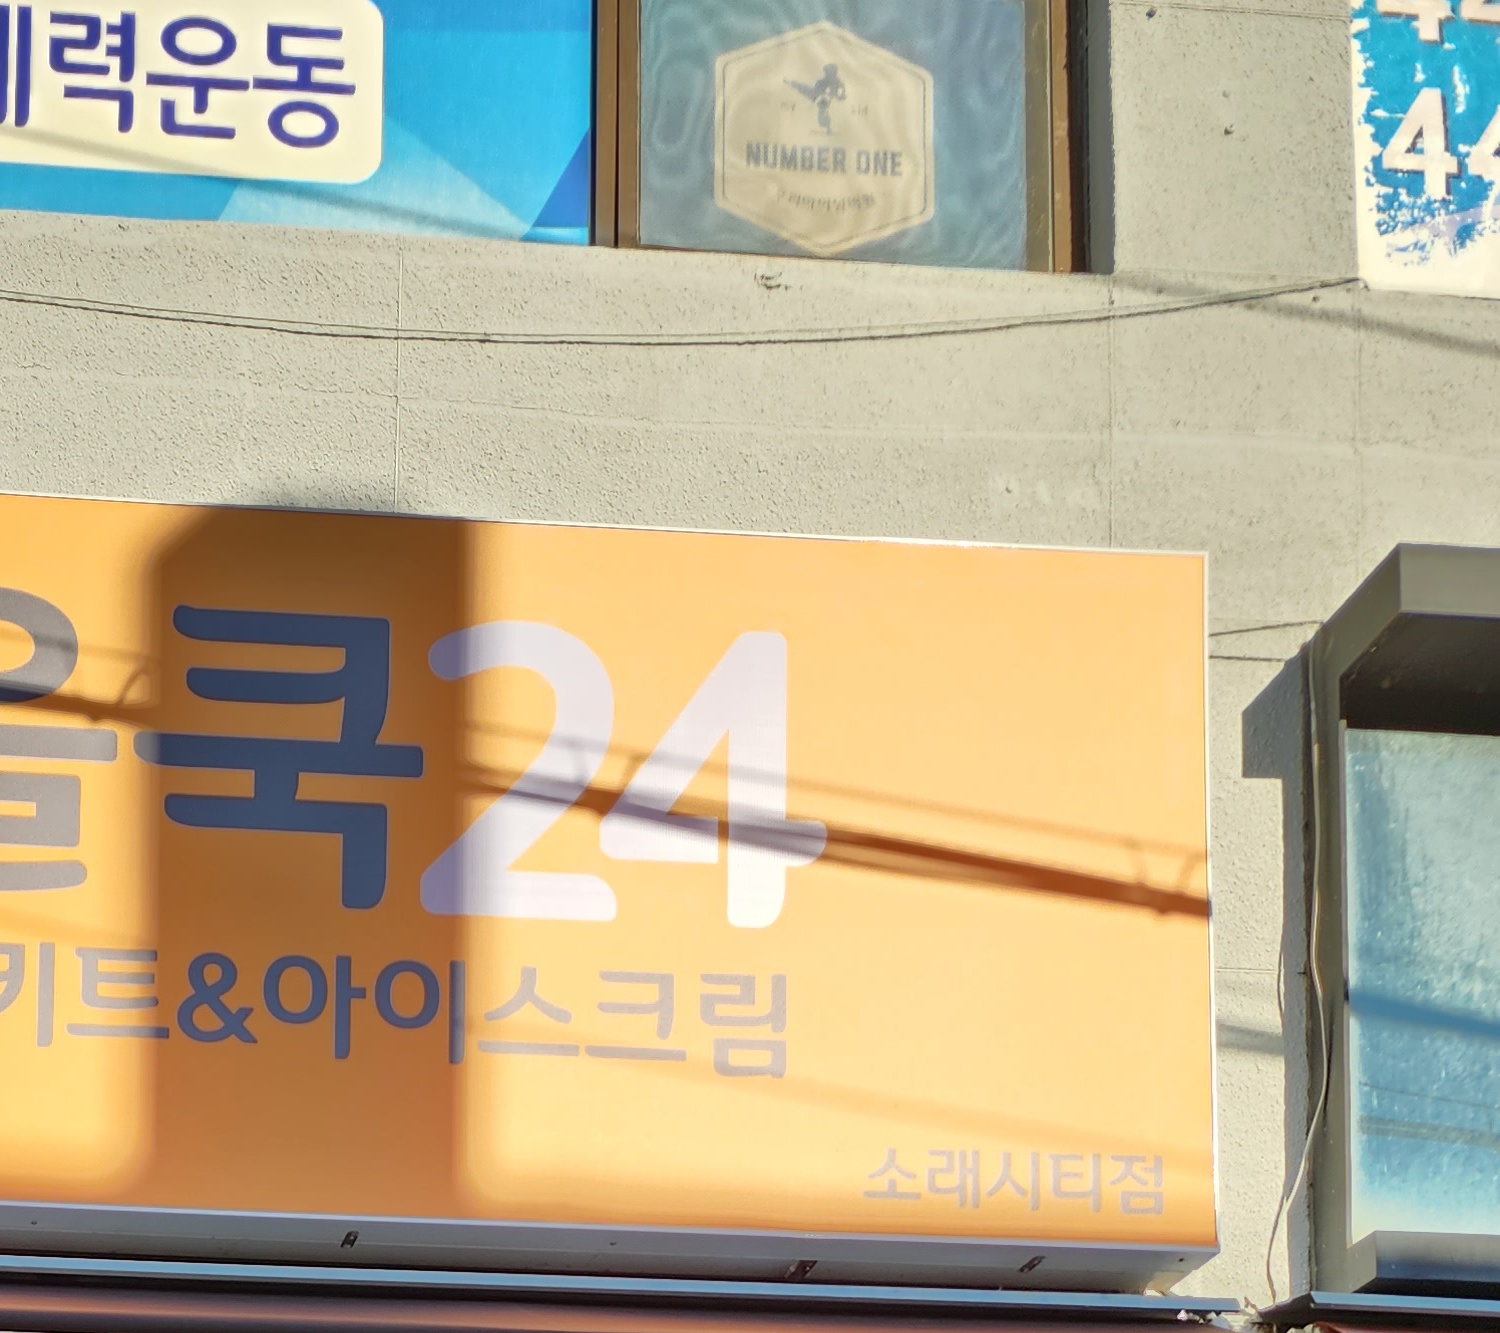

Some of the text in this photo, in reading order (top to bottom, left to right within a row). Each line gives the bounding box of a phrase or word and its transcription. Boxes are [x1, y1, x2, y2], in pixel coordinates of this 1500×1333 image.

[745, 140, 903, 177] NUMBER ONE
[862, 1147, 1166, 1216] 소래시티점
